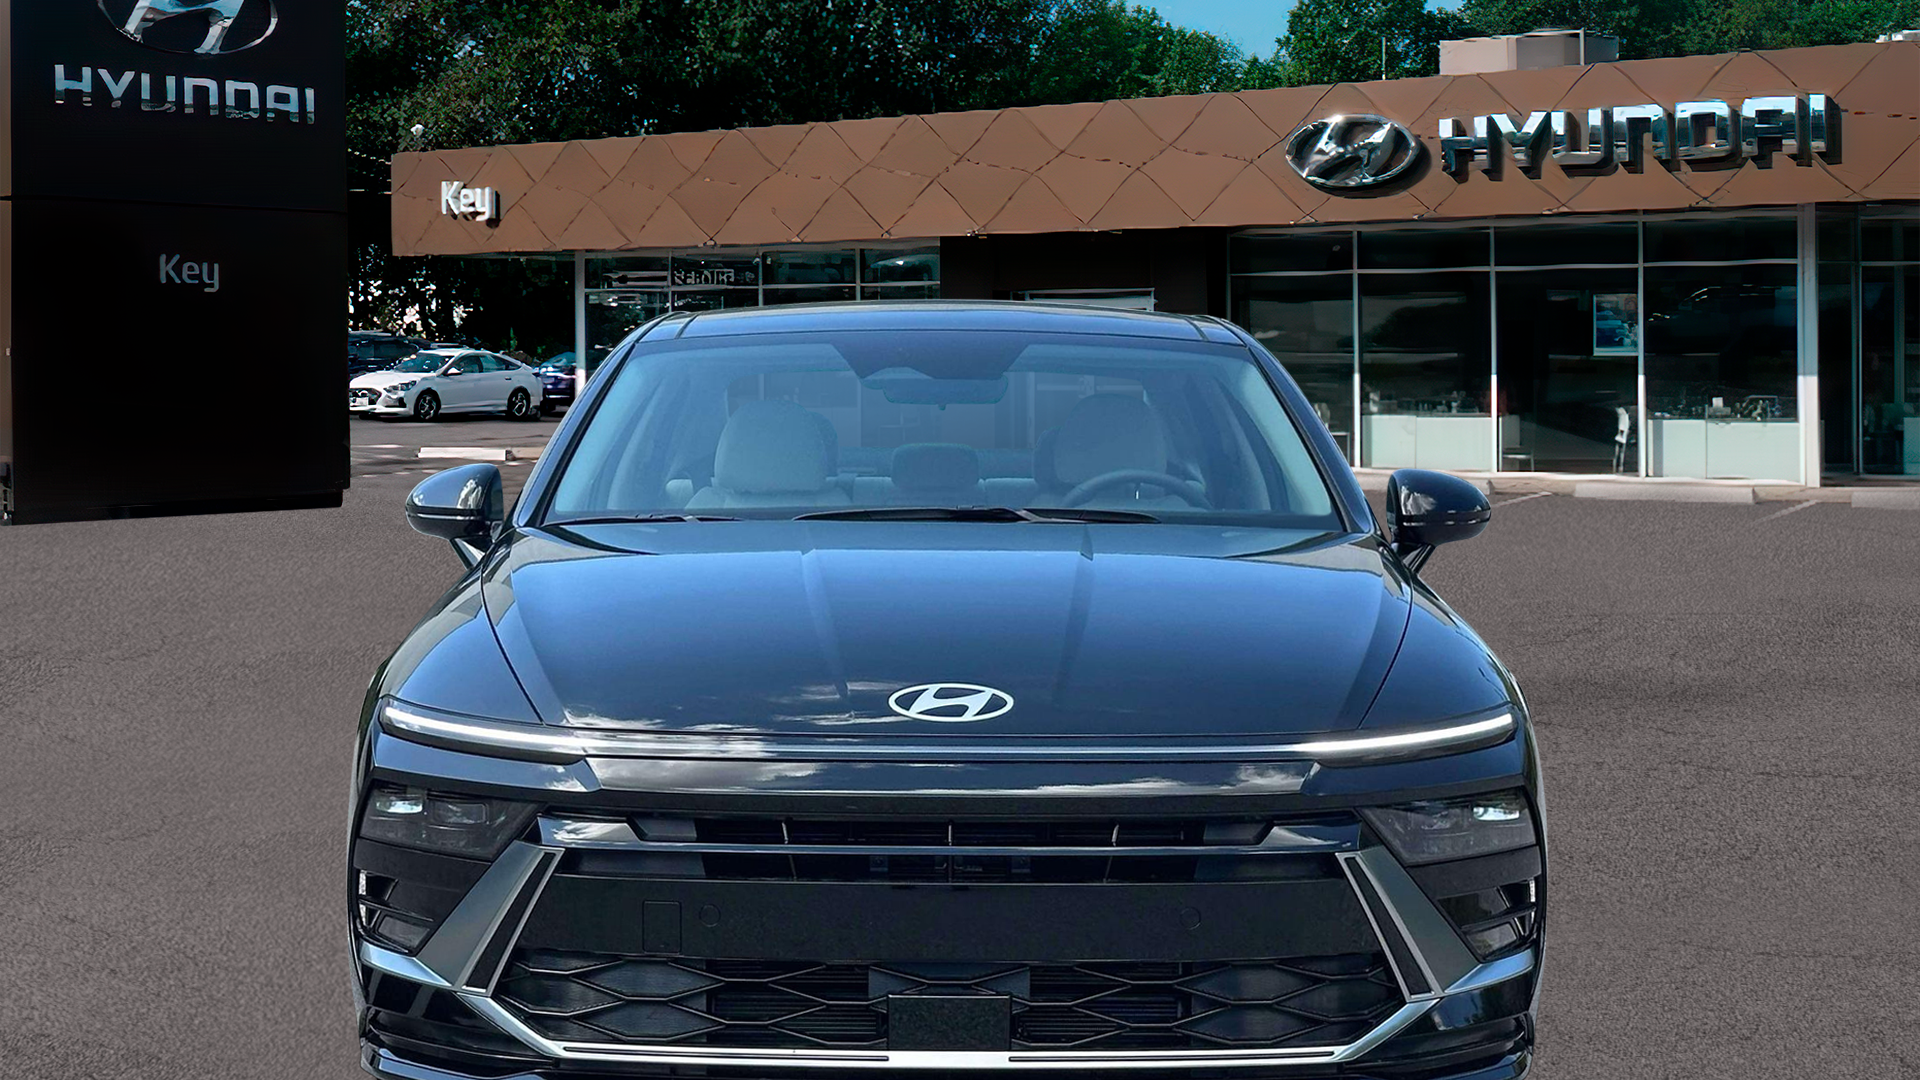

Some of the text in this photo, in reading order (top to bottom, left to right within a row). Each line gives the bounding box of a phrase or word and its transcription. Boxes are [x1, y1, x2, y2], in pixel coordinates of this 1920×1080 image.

[54, 64, 315, 125] HYUNDAI
[1438, 93, 1842, 182] HYUNDAI
[441, 181, 493, 222] Key
[159, 253, 220, 293] Key
